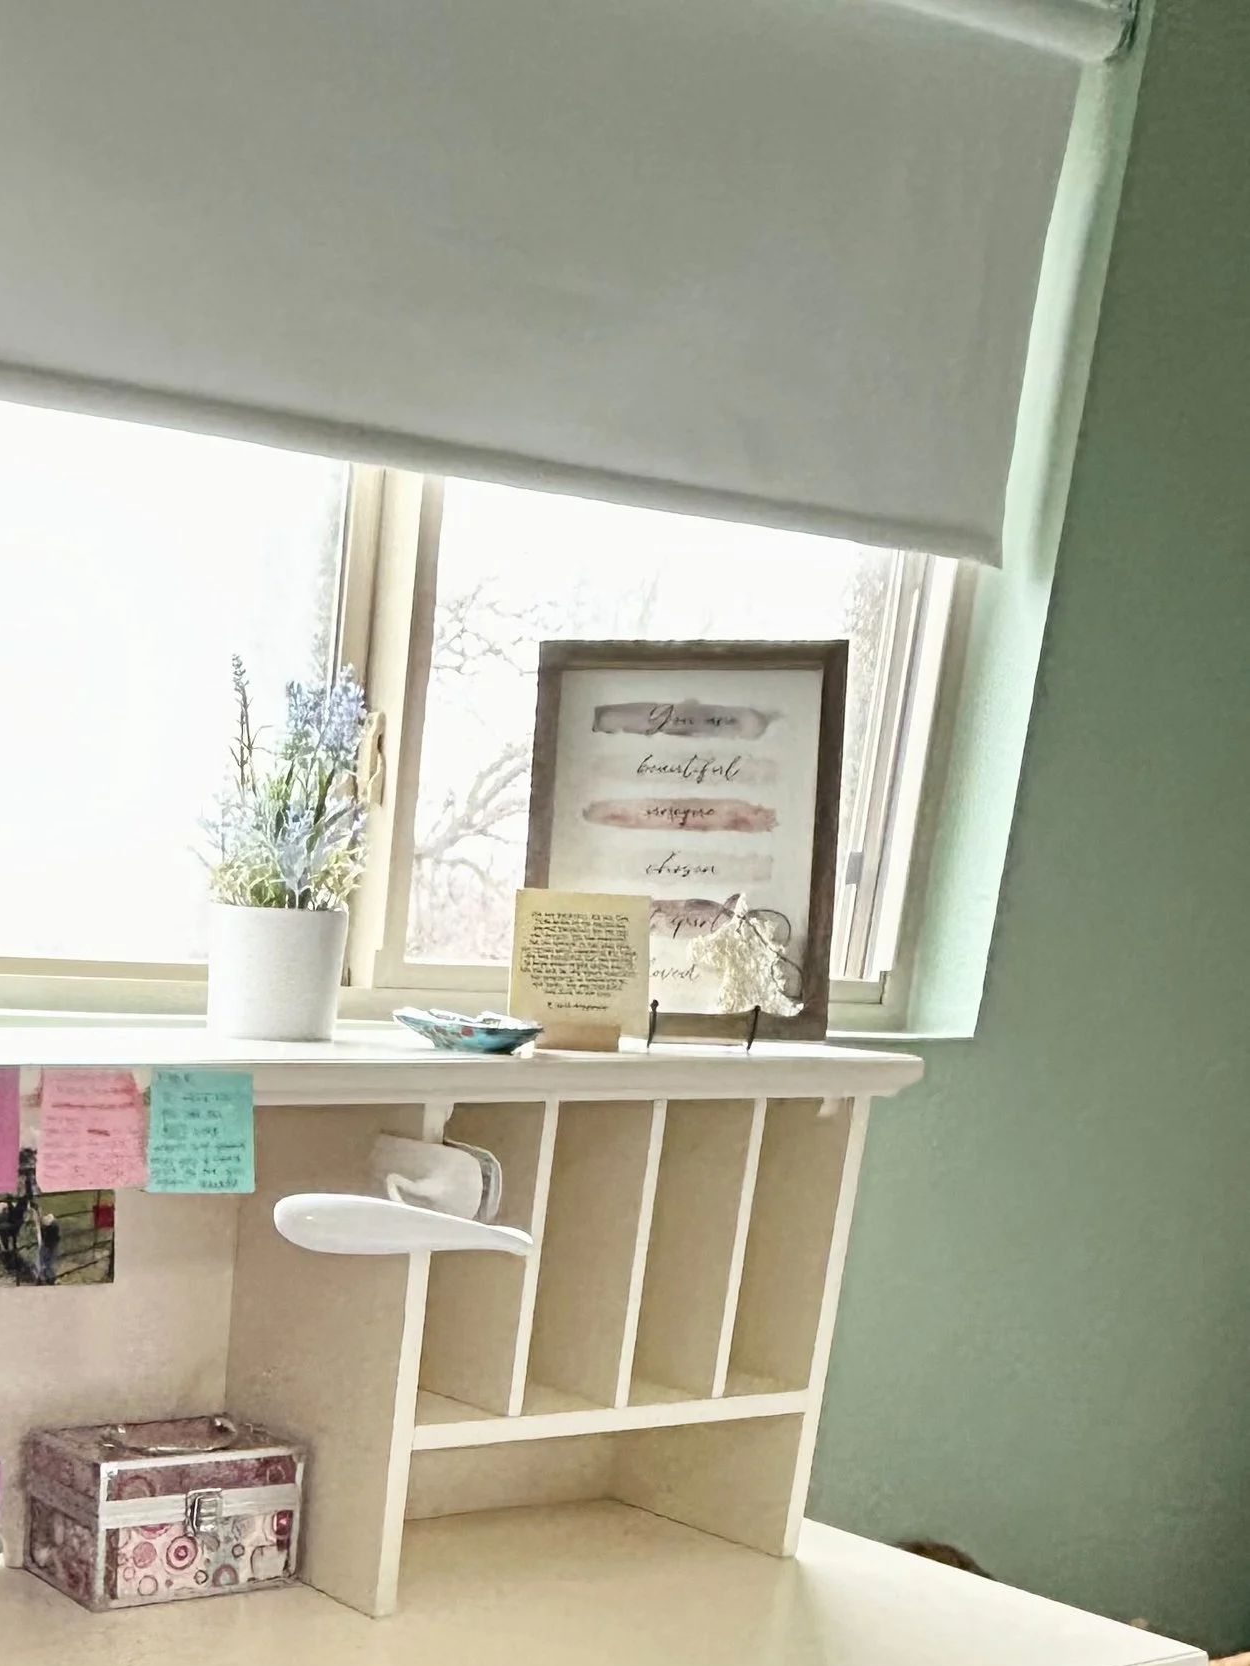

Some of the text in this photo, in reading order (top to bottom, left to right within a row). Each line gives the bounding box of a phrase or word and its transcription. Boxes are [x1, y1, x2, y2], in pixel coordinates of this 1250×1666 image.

[706, 716, 738, 728] are
[636, 753, 741, 784] beautiful
[646, 807, 716, 827] unique
[645, 851, 716, 878] chosen
